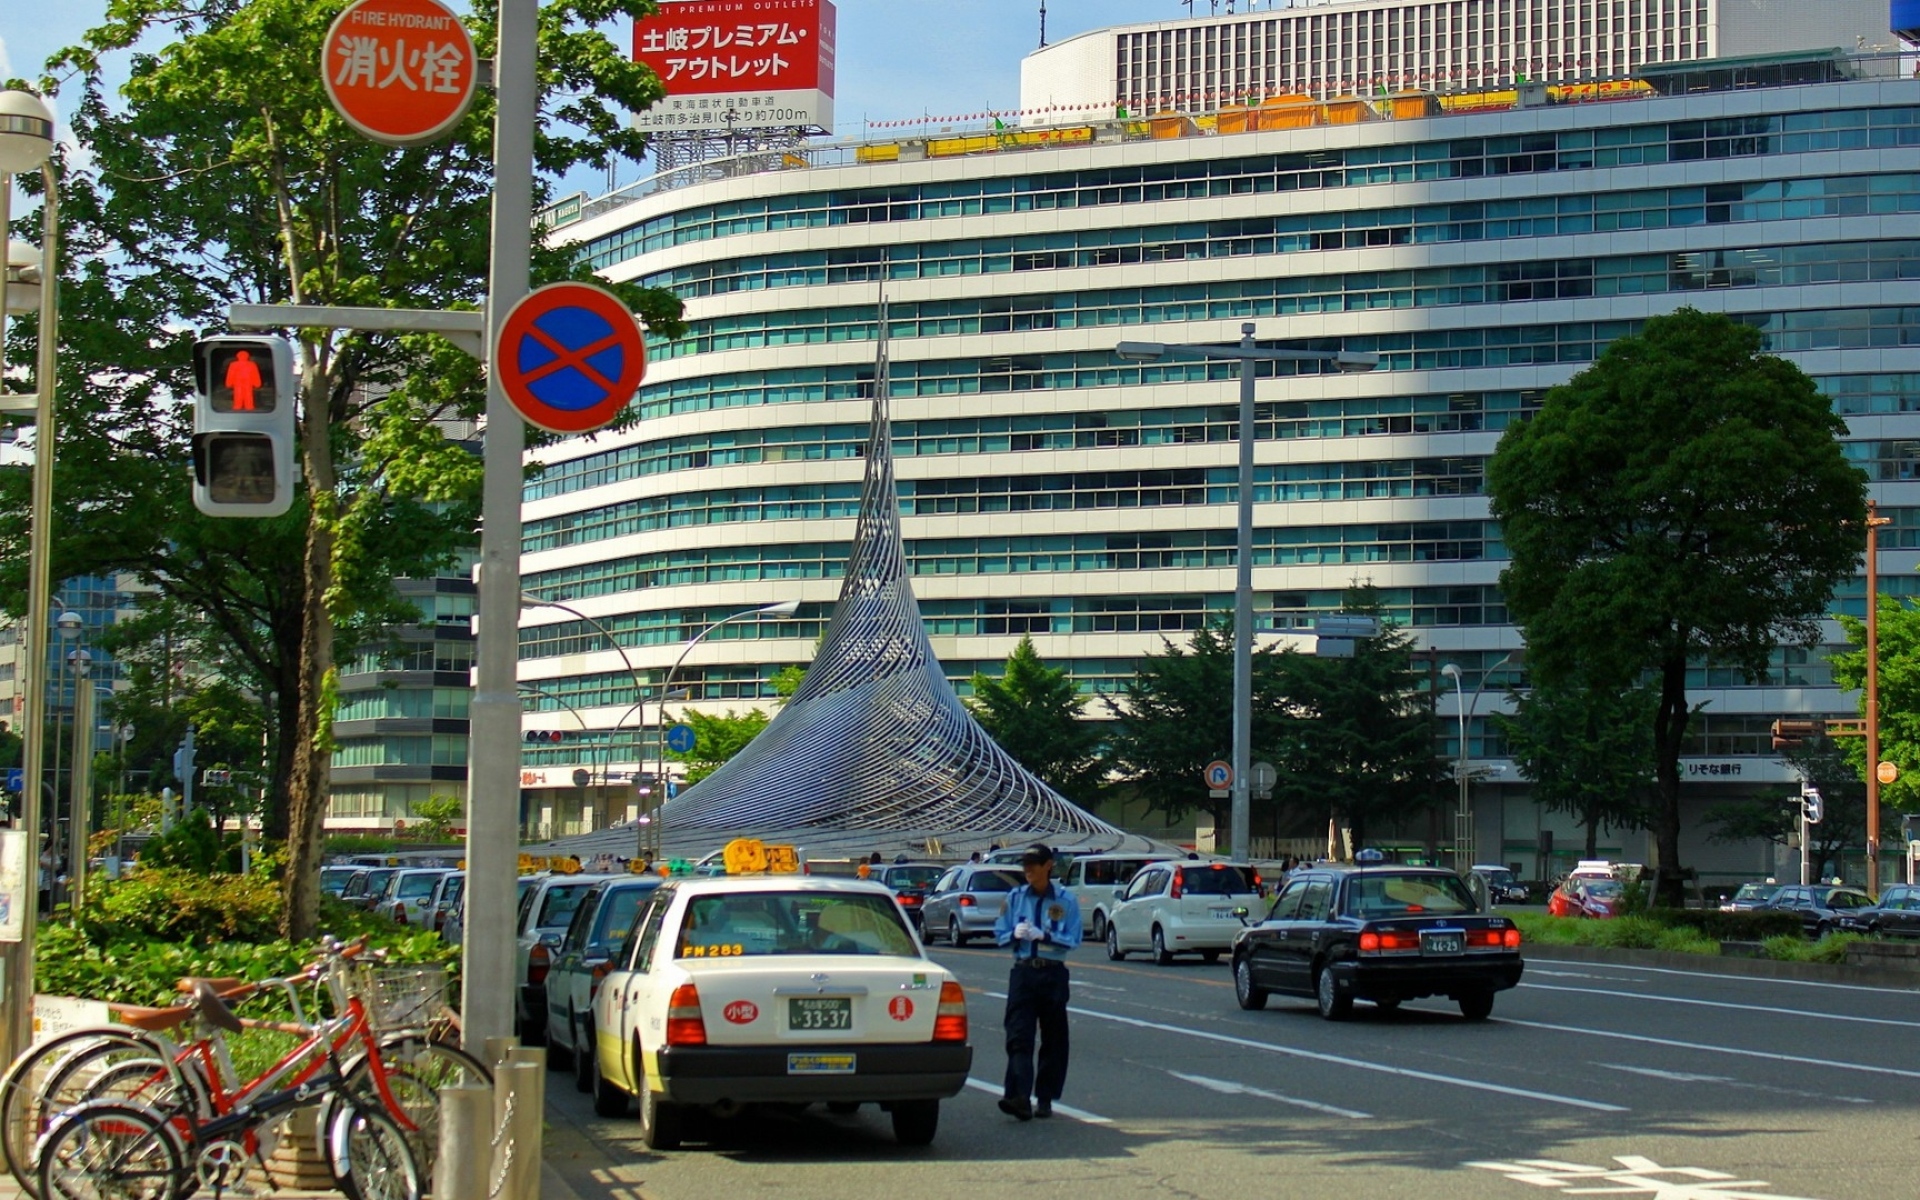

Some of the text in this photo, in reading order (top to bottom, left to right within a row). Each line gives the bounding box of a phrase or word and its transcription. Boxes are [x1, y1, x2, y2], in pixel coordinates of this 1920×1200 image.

[680, 3, 743, 14] PREMIUM
[754, 0, 814, 10] OUTLETS
[352, 10, 452, 31] FIRE HYDRANT
[335, 34, 465, 94] 消火栓
[665, 52, 790, 81] アウトレット
[673, 96, 775, 110] 東海環状自動車道
[1689, 763, 1742, 776] りそな銀行
[682, 943, 743, 959] FM 283
[1432, 940, 1458, 951] 46-29
[728, 1004, 756, 1020] 小型
[802, 1010, 850, 1028] 33-37
